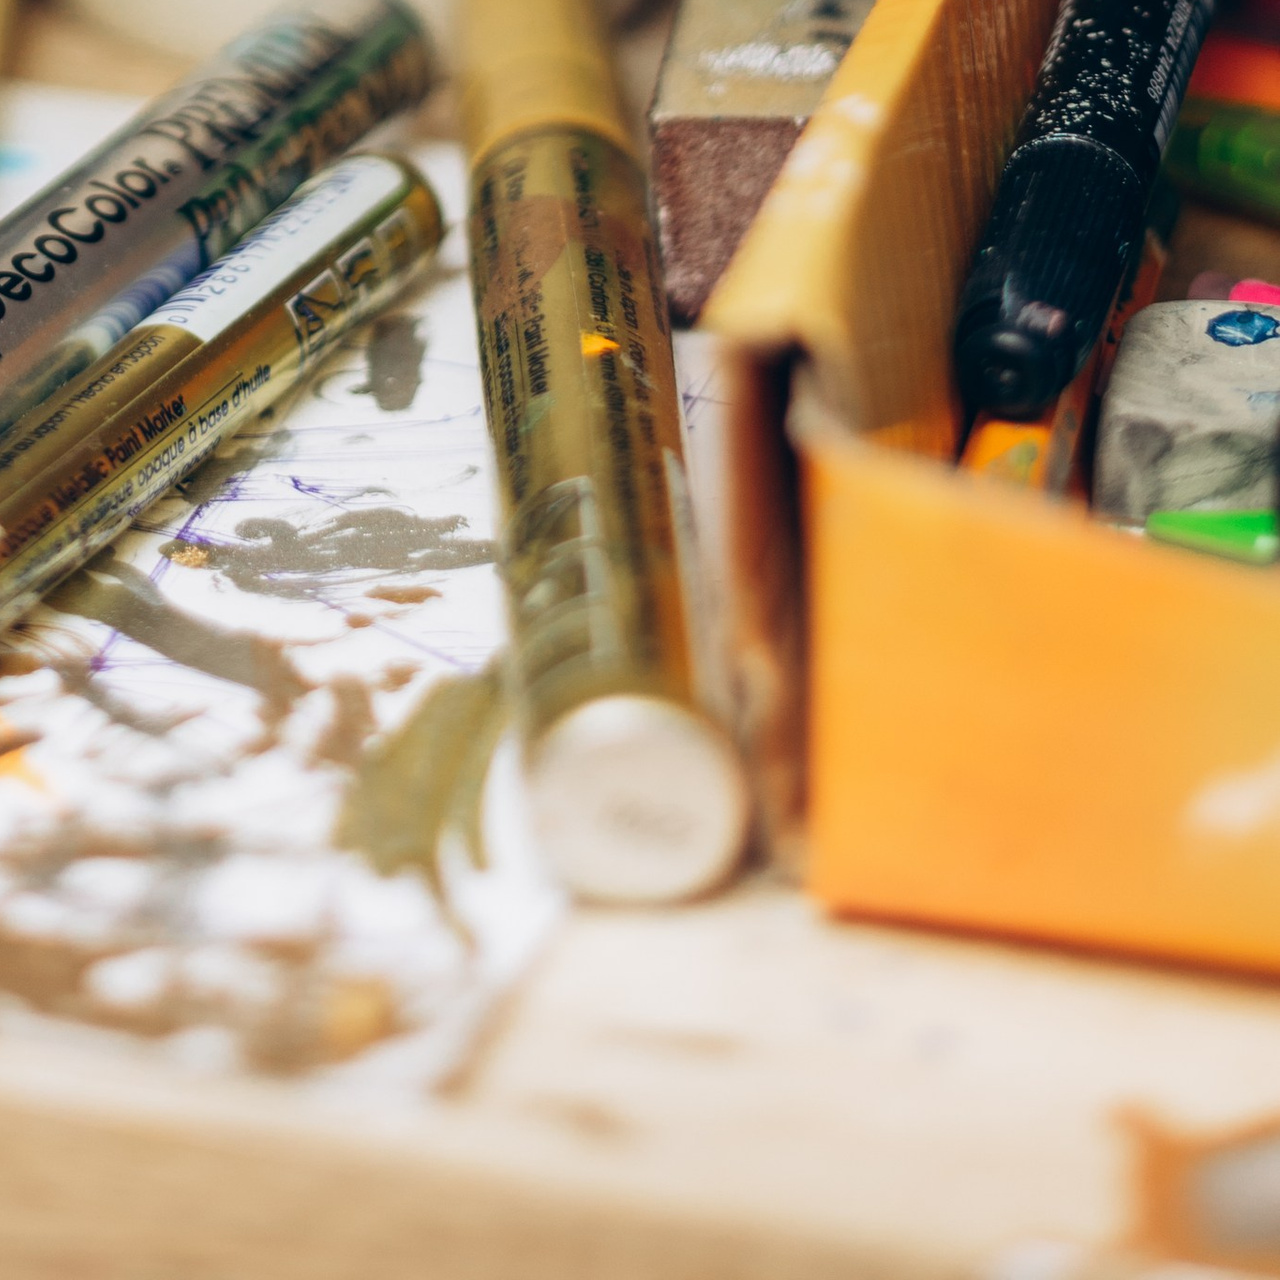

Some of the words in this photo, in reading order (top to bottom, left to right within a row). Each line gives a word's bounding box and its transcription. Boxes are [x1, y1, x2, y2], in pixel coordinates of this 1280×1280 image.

[521, 313, 549, 350] Paint
[111, 357, 131, 377] en
[525, 346, 555, 396] Marker
[99, 425, 146, 471] Paint
[134, 389, 192, 444] Marker
[131, 433, 190, 489] opaque
[193, 396, 235, 435] base
